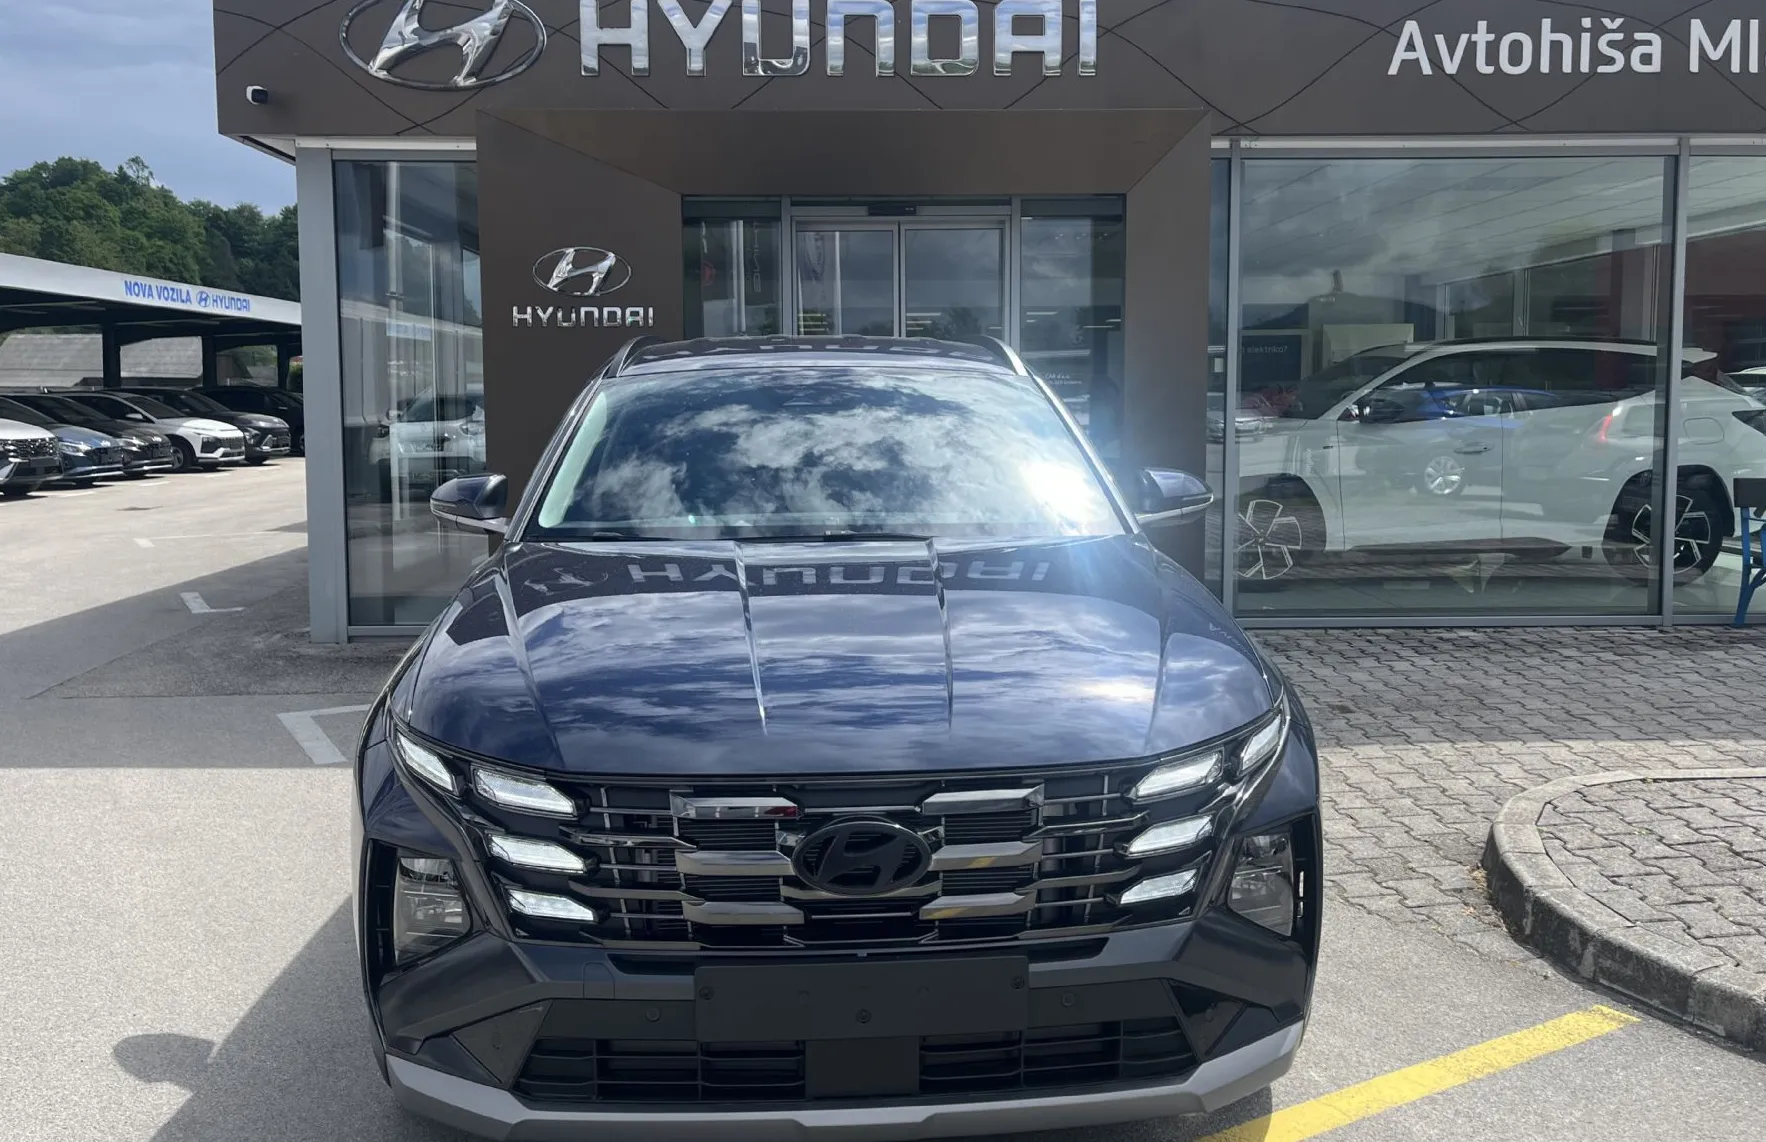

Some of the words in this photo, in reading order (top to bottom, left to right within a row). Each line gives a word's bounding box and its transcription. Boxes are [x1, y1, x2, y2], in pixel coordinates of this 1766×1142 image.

[580, 0, 1097, 77] HYUNDAI
[1387, 17, 1662, 76] Avtohiša
[1689, 18, 1766, 74] Ml
[124, 280, 154, 299] NOVA
[156, 285, 192, 304] VOZILA
[212, 294, 250, 312] HYUNDAI
[512, 306, 654, 327] HYUNDAI
